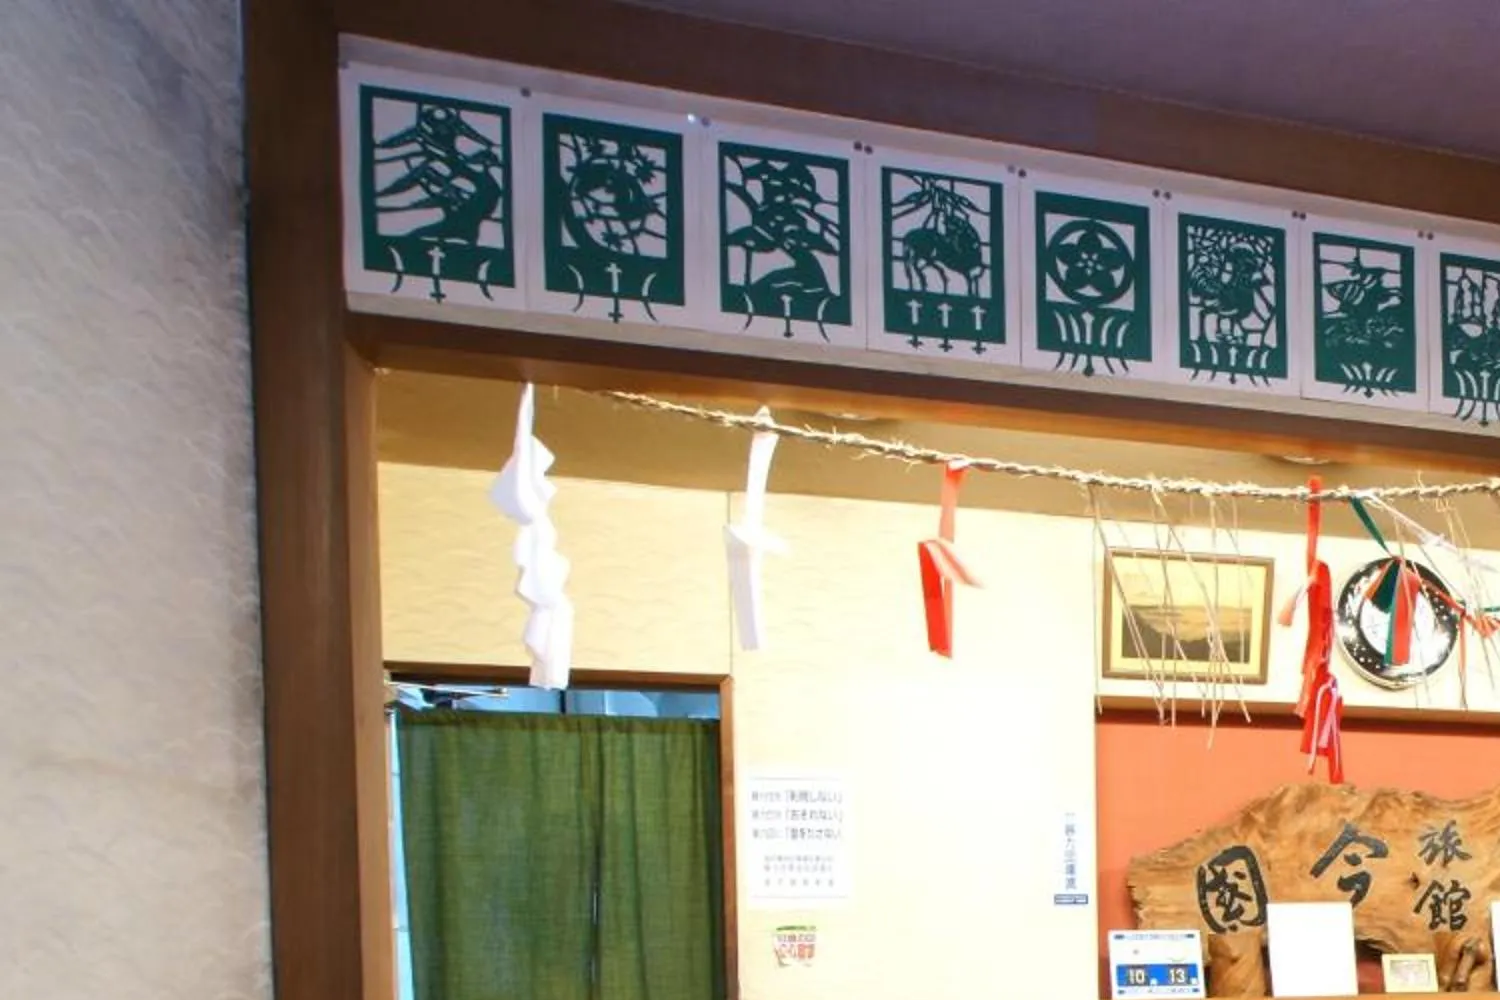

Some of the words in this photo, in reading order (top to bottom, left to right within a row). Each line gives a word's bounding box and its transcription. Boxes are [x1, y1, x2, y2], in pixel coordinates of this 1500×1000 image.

[1413, 820, 1472, 931] 旅館
[1128, 968, 1145, 985] 10
[1169, 967, 1186, 984] 13
